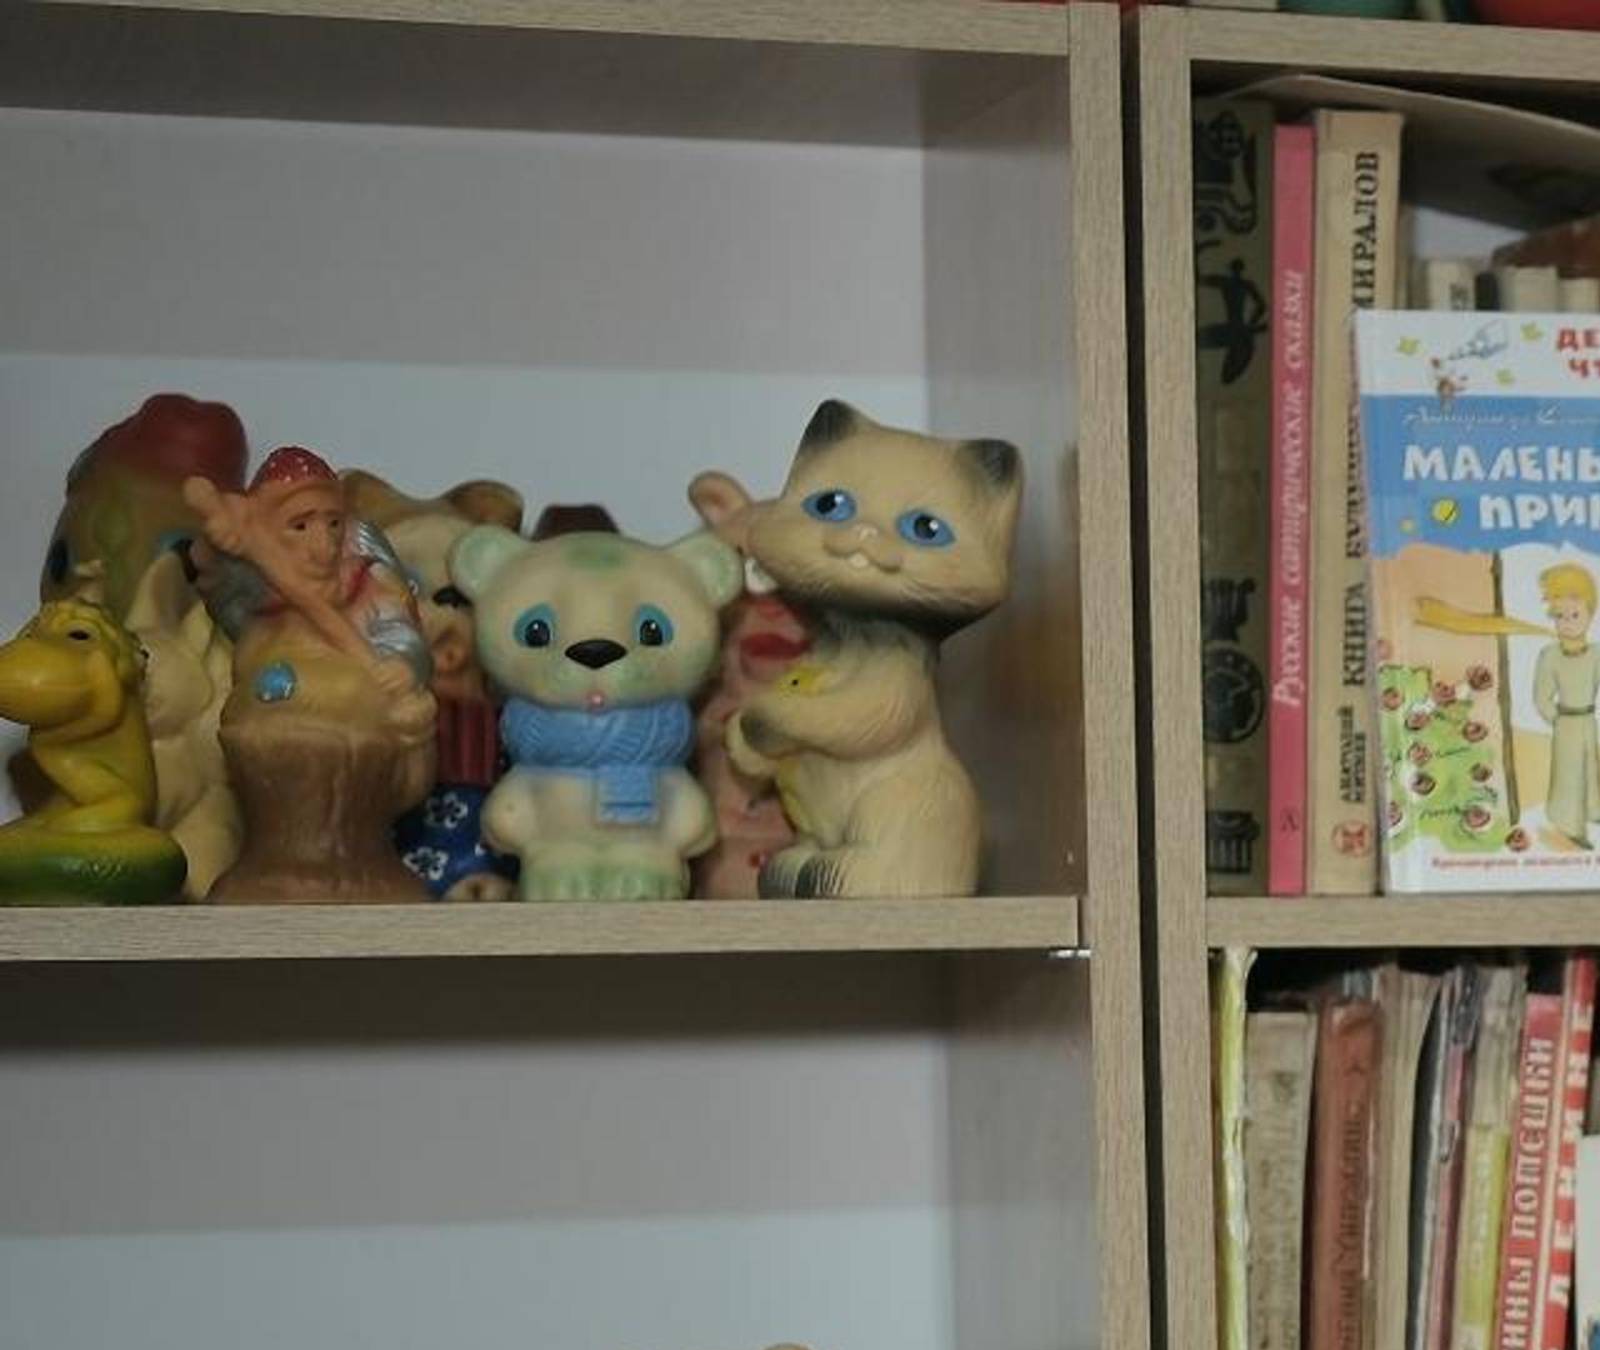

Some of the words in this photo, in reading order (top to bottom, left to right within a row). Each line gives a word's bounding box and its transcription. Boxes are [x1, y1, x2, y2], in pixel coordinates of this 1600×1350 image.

[1351, 152, 1379, 308] ИРАЛОВ
[1284, 270, 1306, 370] сказки
[1280, 387, 1308, 584] сатирические
[1272, 596, 1305, 709] Русские
[1343, 582, 1367, 688] КНИГА
[1550, 999, 1595, 1309] ЛЕНИНЕ
